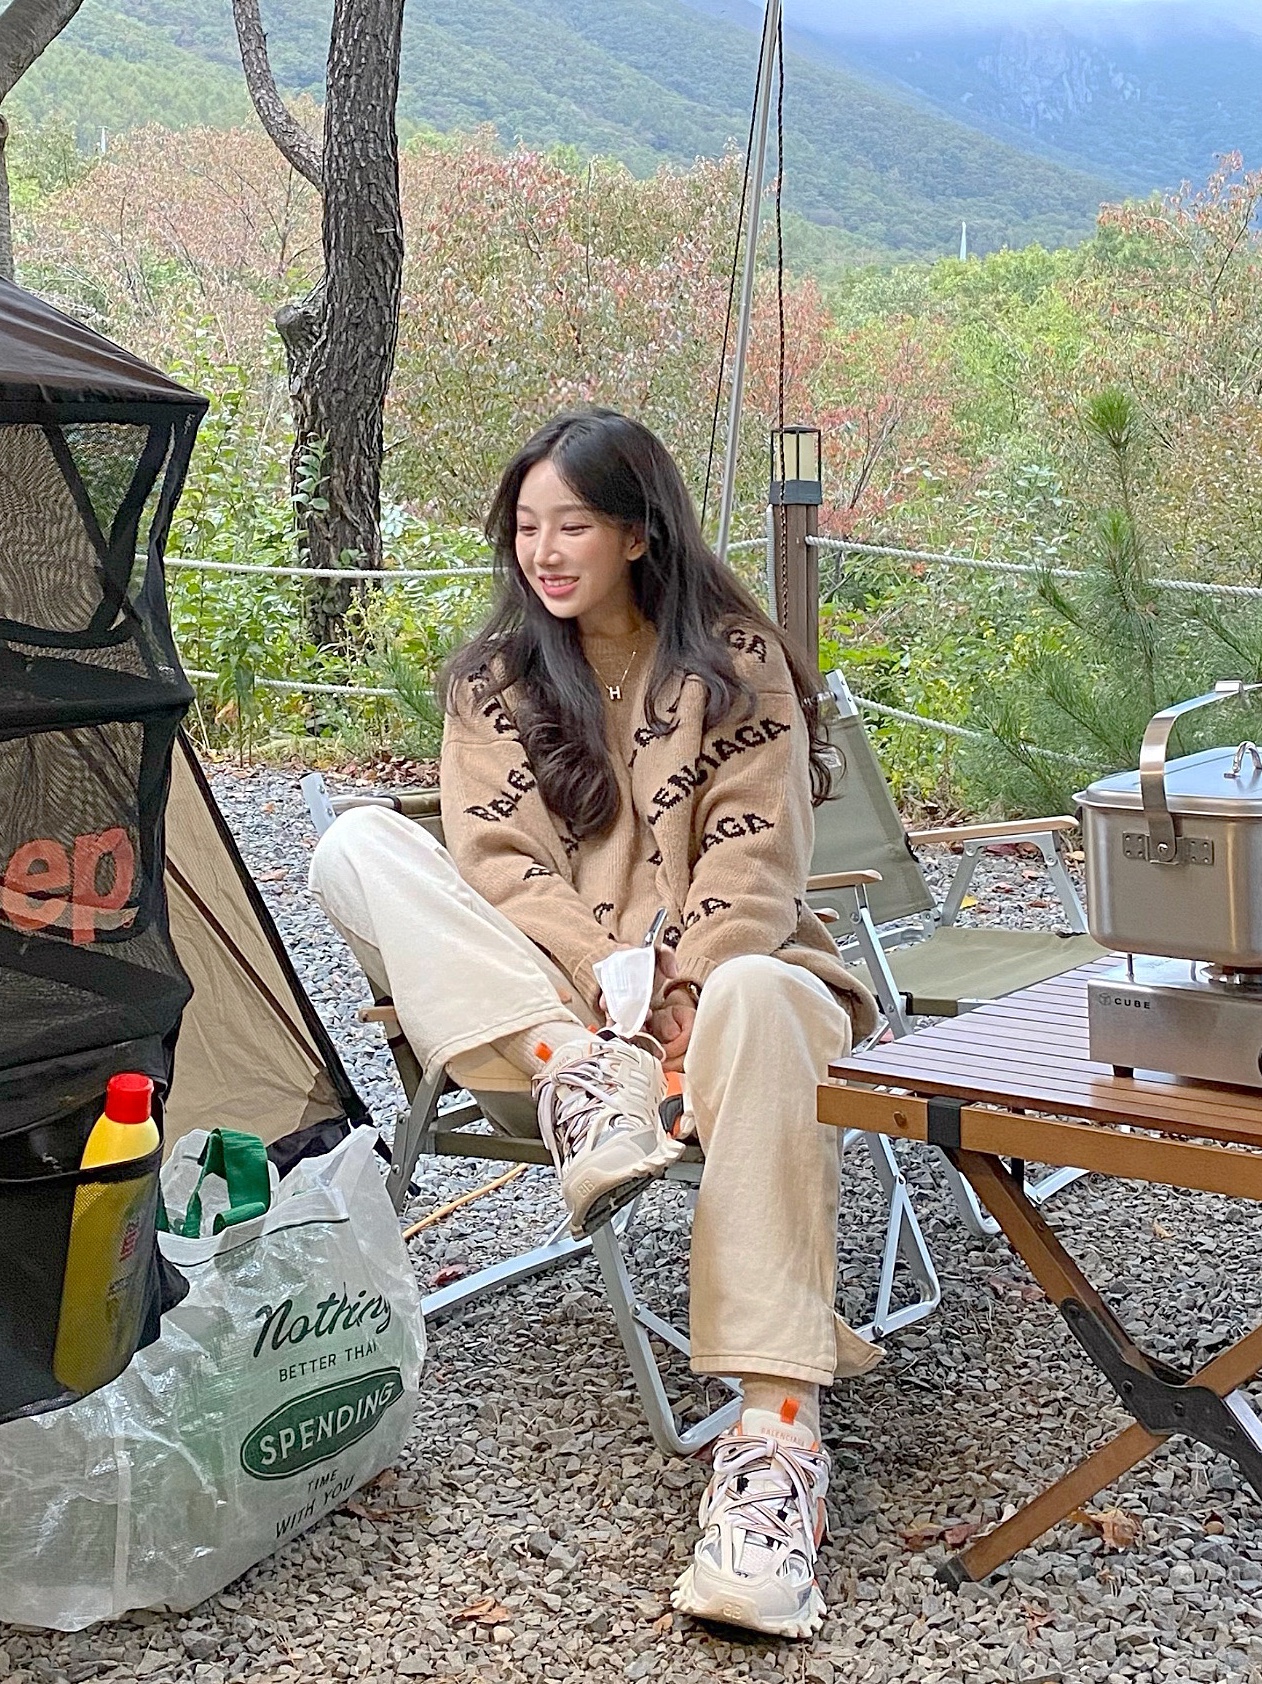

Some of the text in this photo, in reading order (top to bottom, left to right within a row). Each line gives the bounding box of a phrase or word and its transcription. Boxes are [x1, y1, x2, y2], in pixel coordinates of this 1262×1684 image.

[609, 685, 621, 700] H
[1114, 997, 1150, 1010] CUBE
[253, 1281, 392, 1358] Nothing
[279, 1353, 337, 1382] BETTER
[258, 1381, 396, 1466] SPENDING
[308, 1468, 338, 1494] TIME
[276, 1473, 355, 1539] WITH YOU
